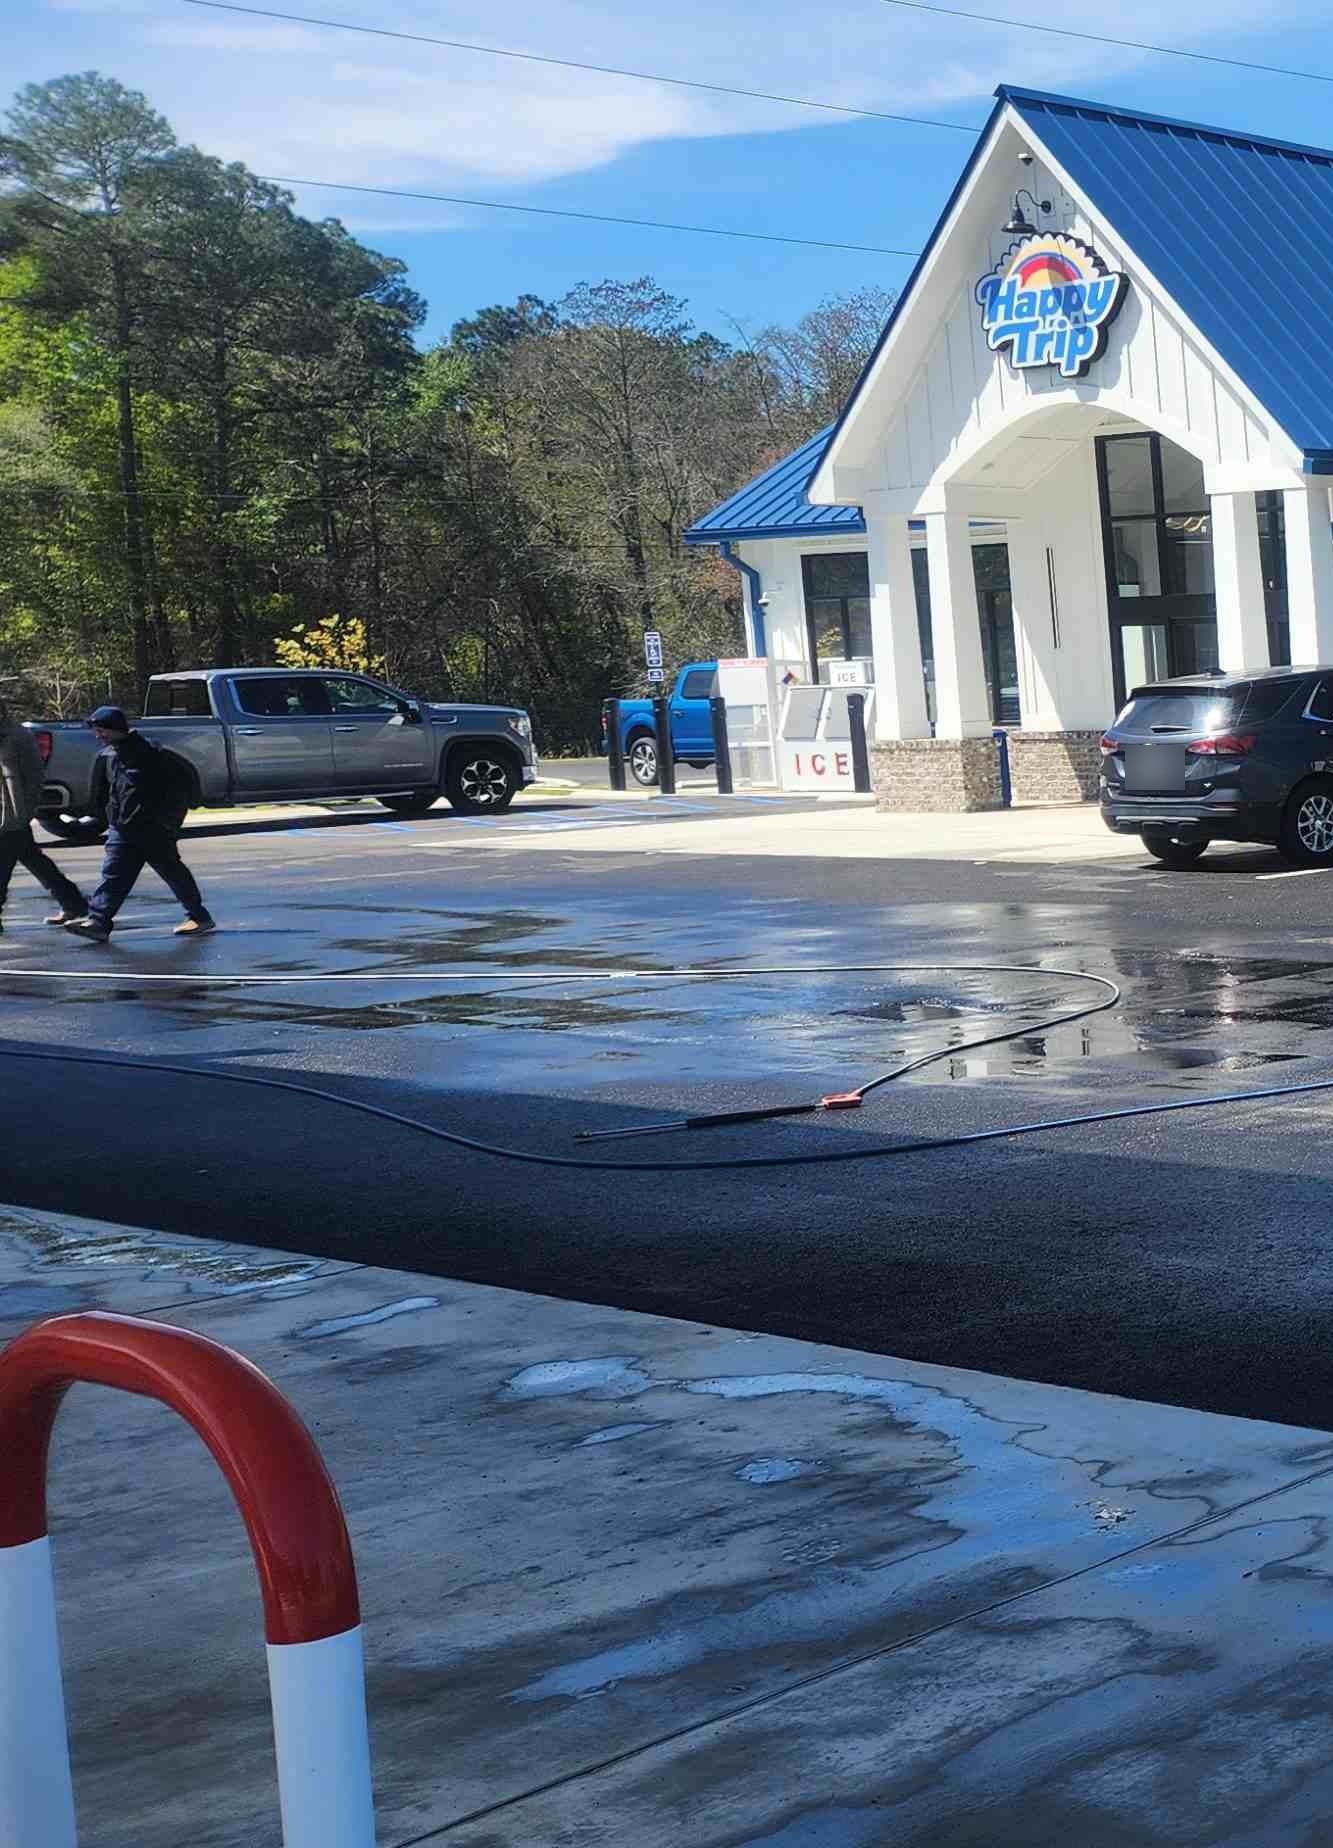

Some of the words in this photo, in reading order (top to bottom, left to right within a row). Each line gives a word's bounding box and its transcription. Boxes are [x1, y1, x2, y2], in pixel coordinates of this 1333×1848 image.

[980, 277, 1117, 324] Happy
[991, 319, 1095, 373] Trip
[837, 672, 857, 683] ICE
[795, 752, 850, 775] ICE
